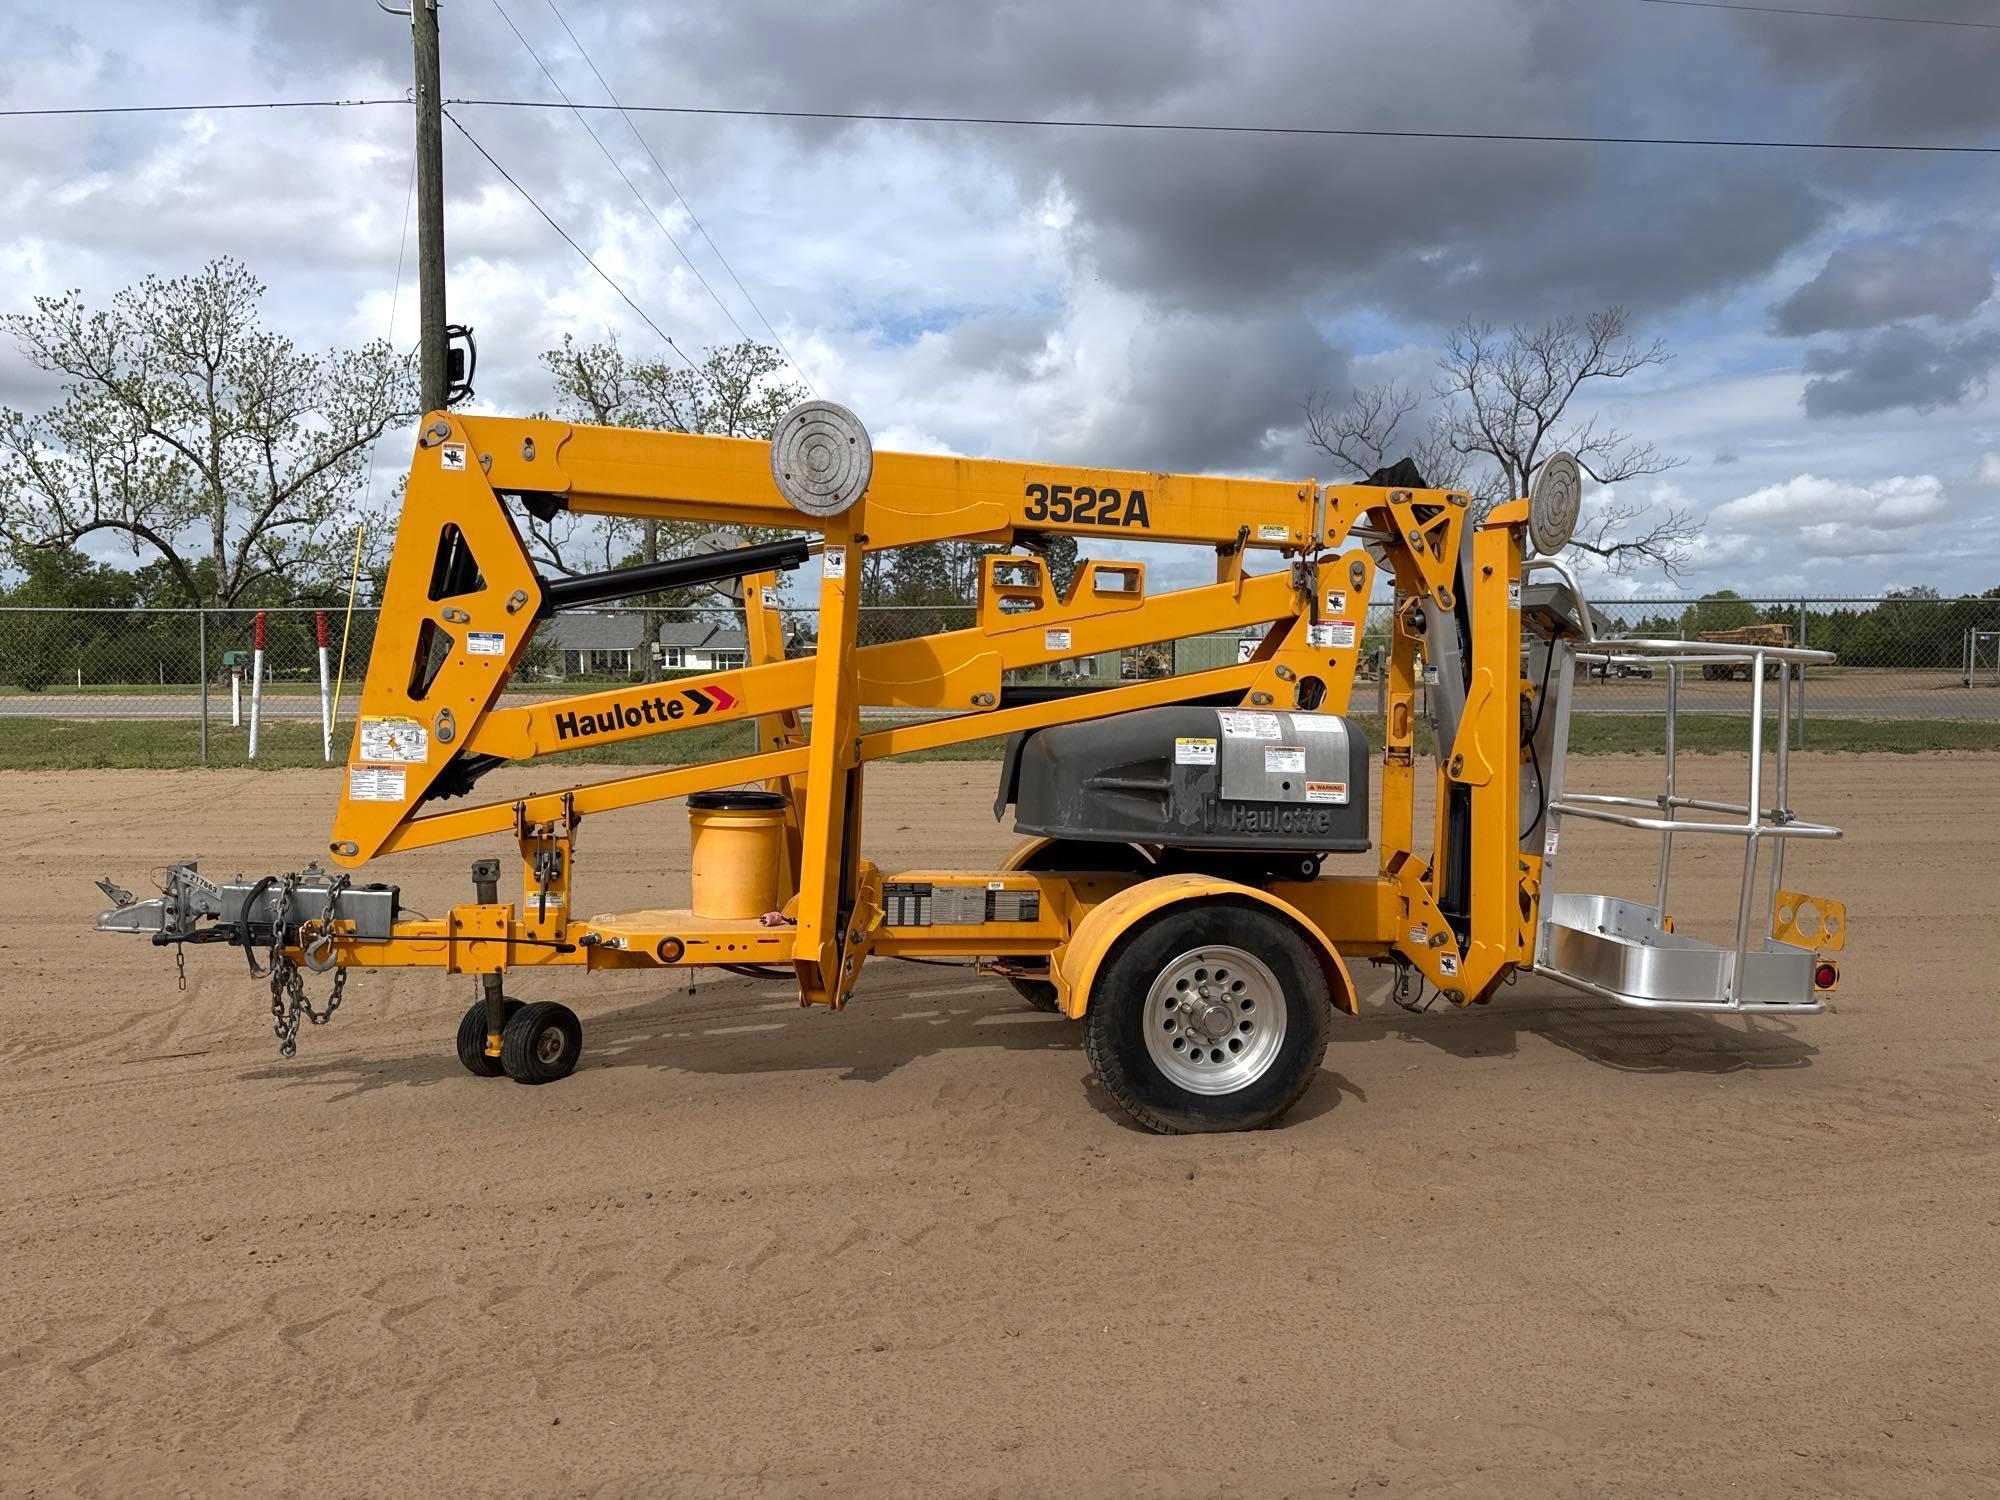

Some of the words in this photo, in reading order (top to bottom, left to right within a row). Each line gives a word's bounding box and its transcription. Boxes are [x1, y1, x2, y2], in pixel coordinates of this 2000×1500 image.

[1024, 483, 1150, 528] 3522A
[555, 697, 684, 740] Haulotte
[1231, 804, 1330, 834] Haulotte
